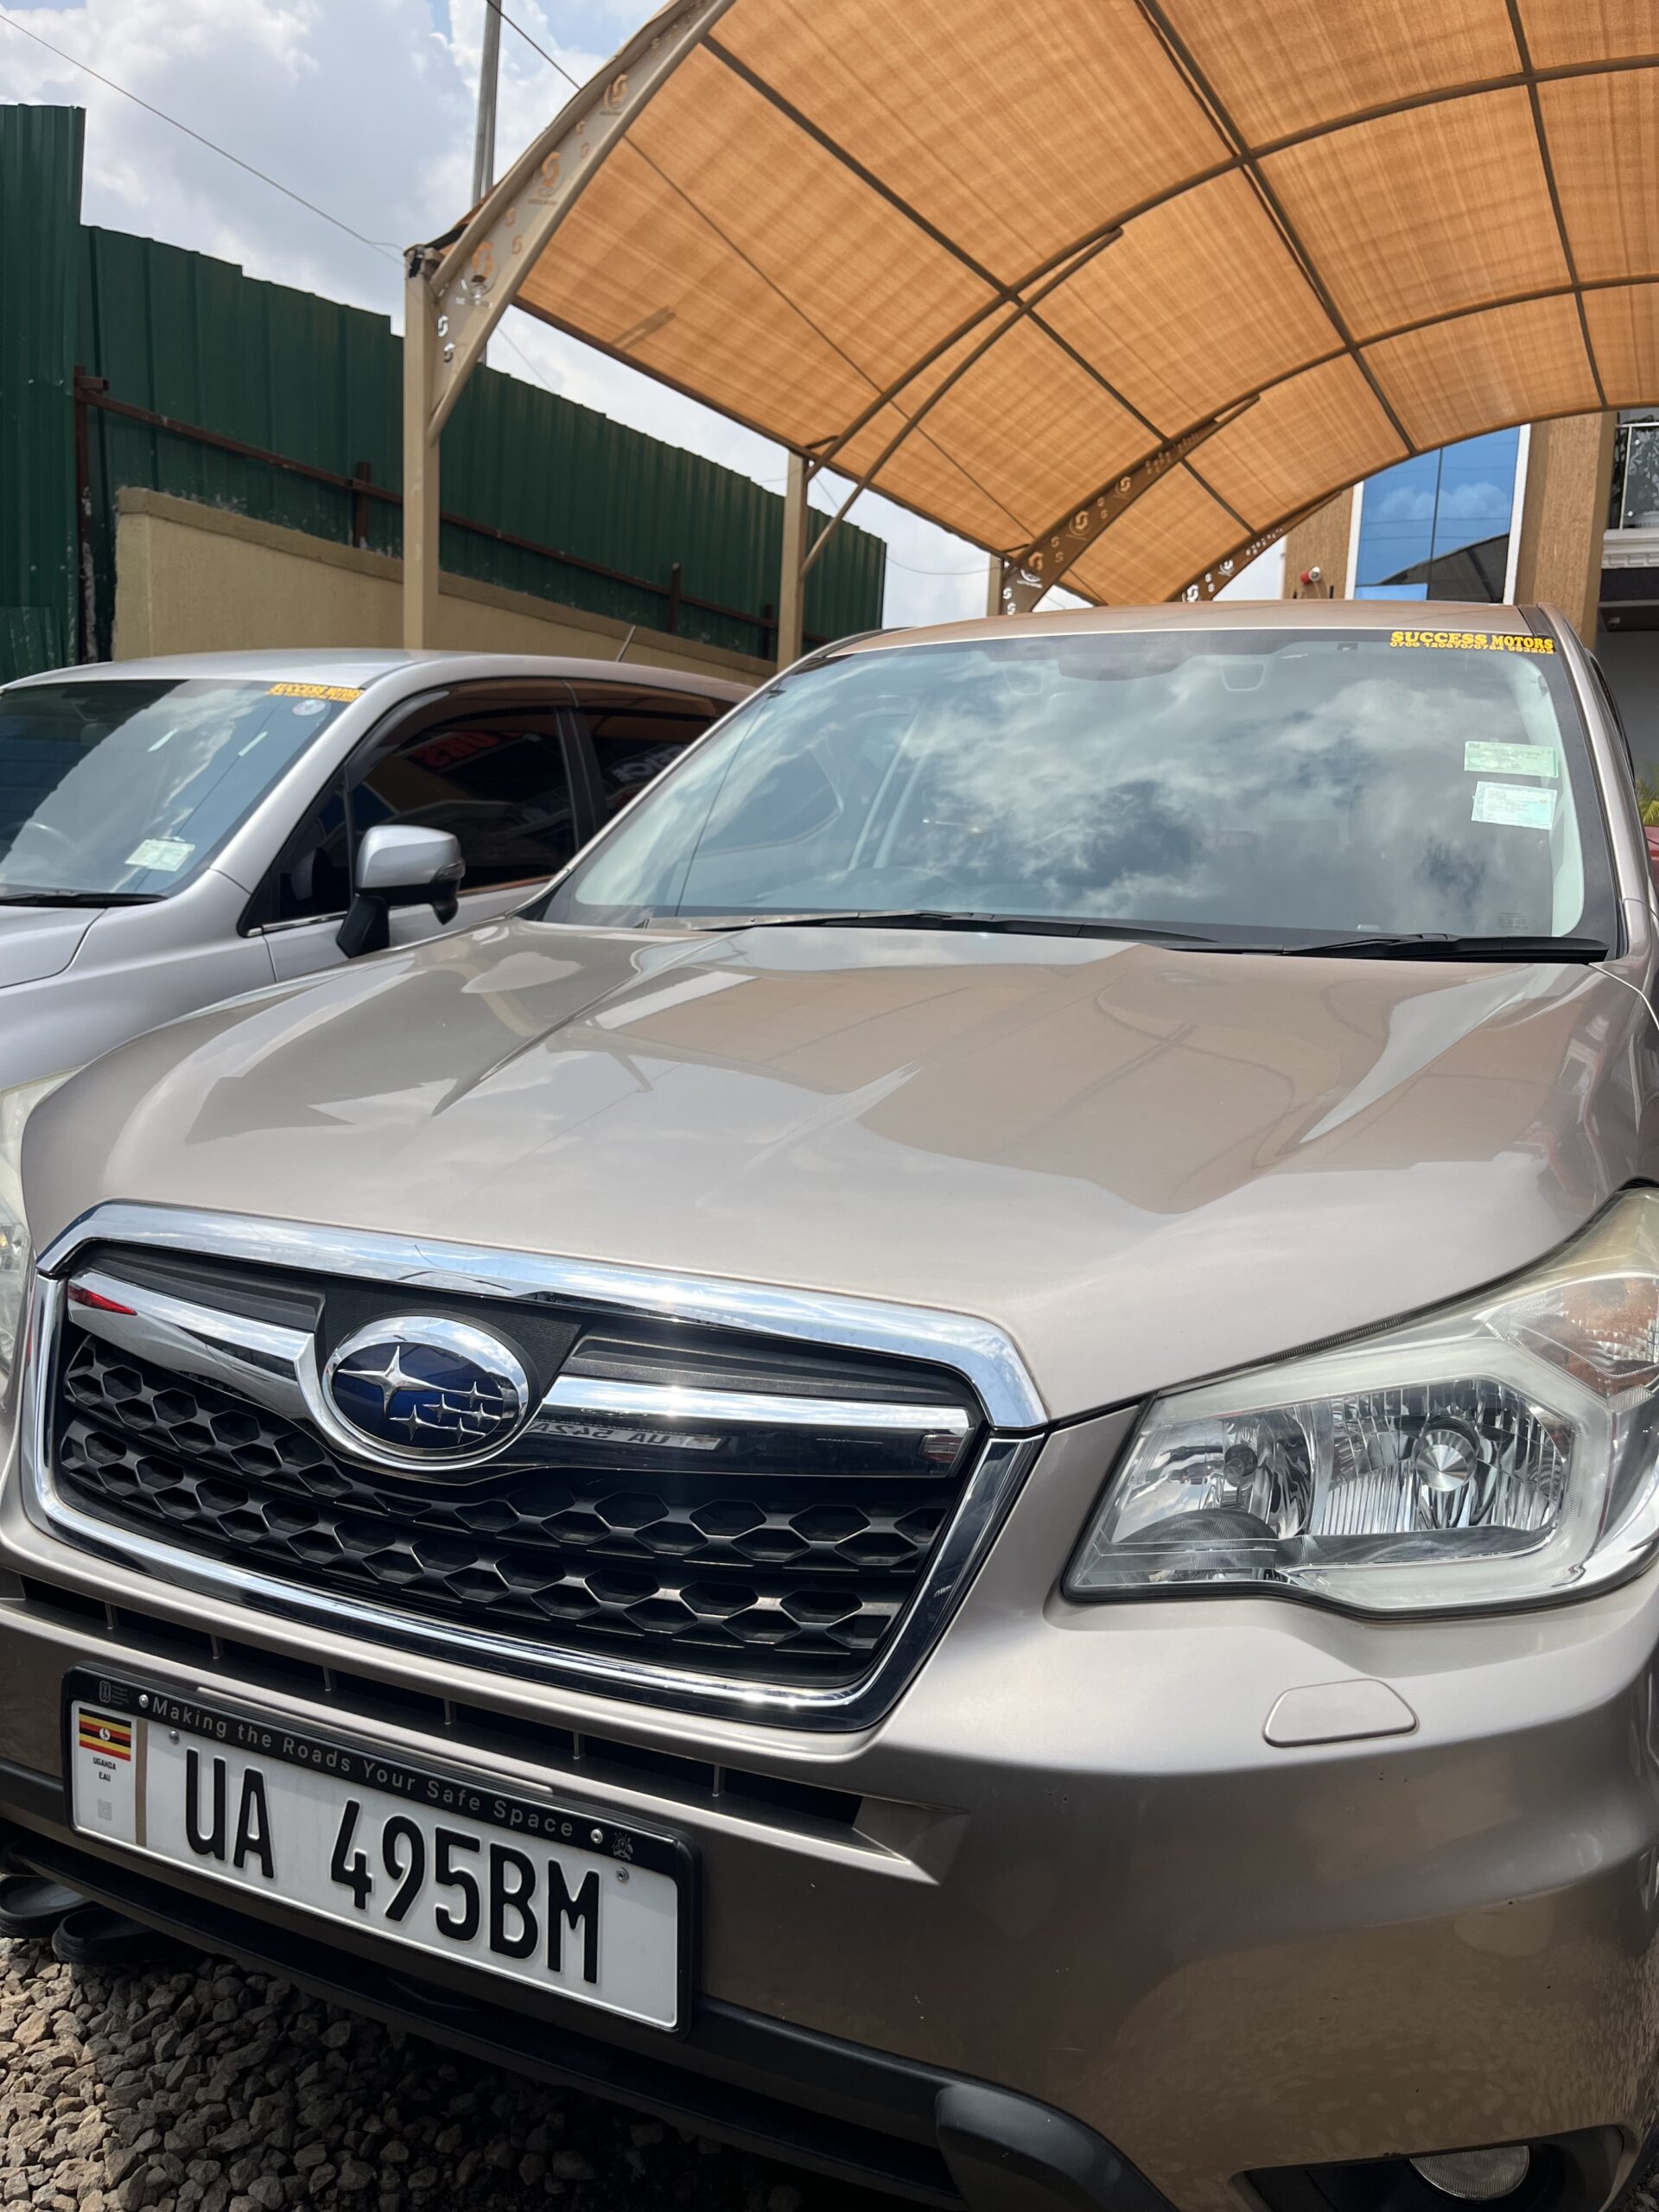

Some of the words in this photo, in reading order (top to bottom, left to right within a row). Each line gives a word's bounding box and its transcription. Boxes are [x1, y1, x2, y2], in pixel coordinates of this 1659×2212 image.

[1391, 631, 1487, 645] SUCCESS
[1491, 635, 1554, 650] MOTORS
[92, 1757, 117, 1770] UGANDA
[153, 1697, 227, 1738] Making
[238, 1724, 272, 1747] the
[283, 1737, 350, 1771] Roads
[364, 1760, 416, 1791] Your
[427, 1780, 480, 1811] Safe
[494, 1800, 574, 1837] Space
[99, 1771, 111, 1782] EAU
[185, 1749, 275, 1880] UA
[330, 1800, 601, 1985] 495BM
